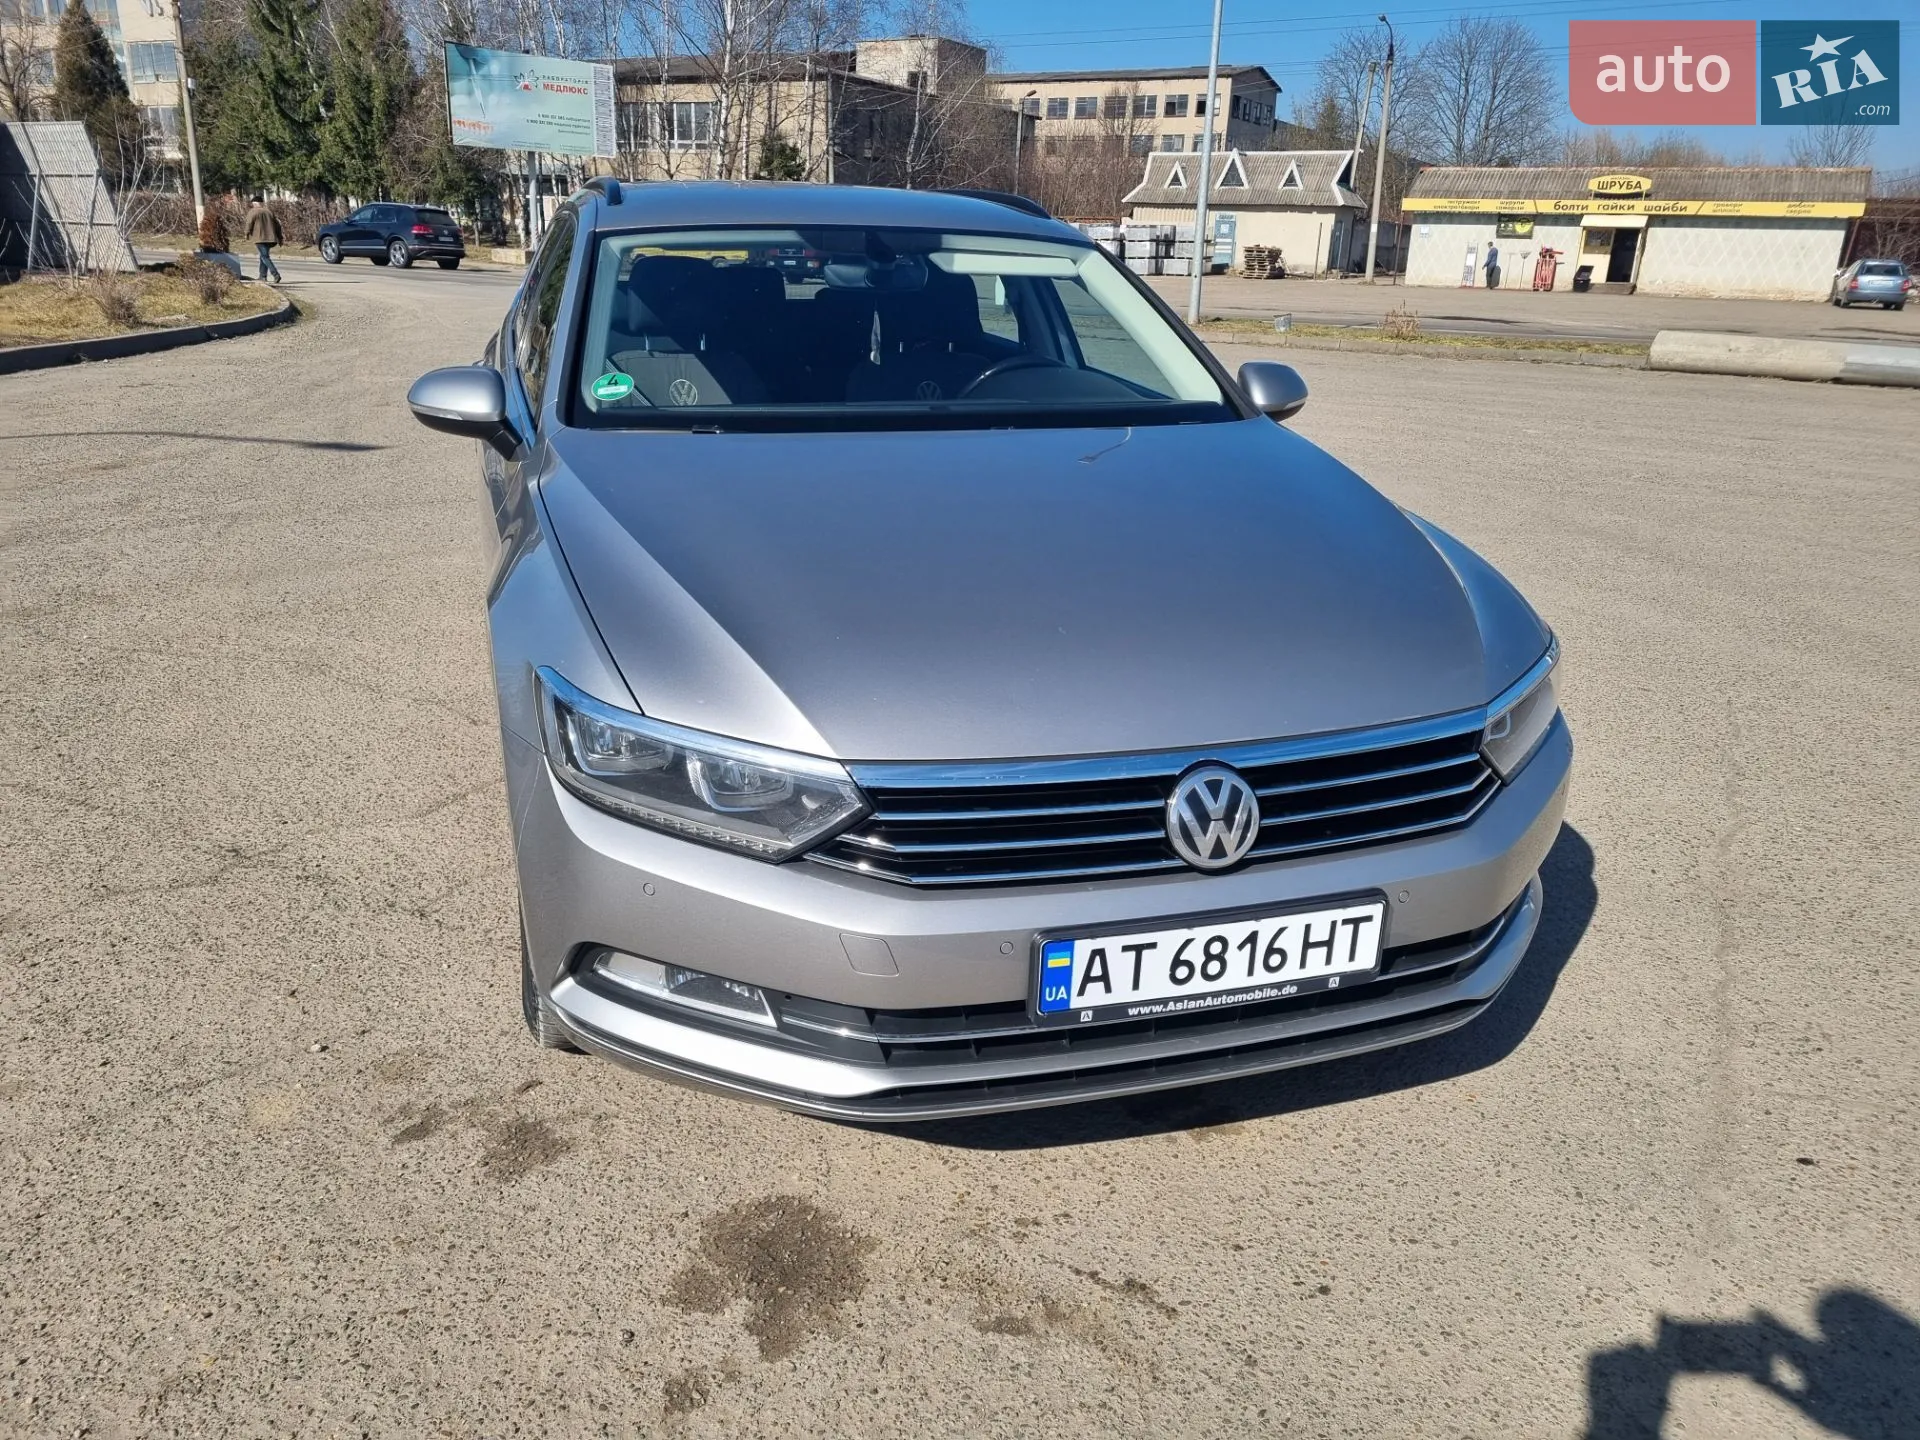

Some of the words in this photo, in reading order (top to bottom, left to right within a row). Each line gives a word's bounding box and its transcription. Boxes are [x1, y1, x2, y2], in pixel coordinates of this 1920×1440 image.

[543, 83, 589, 95] МЕДЛЮКС
[1597, 180, 1642, 190] ШРУБА
[1553, 201, 1589, 211] болти
[1597, 201, 1635, 211] гайки
[1643, 202, 1688, 212] шайби
[607, 375, 619, 387] 4
[1167, 766, 1260, 869] VW
[1045, 985, 1068, 1001] UA
